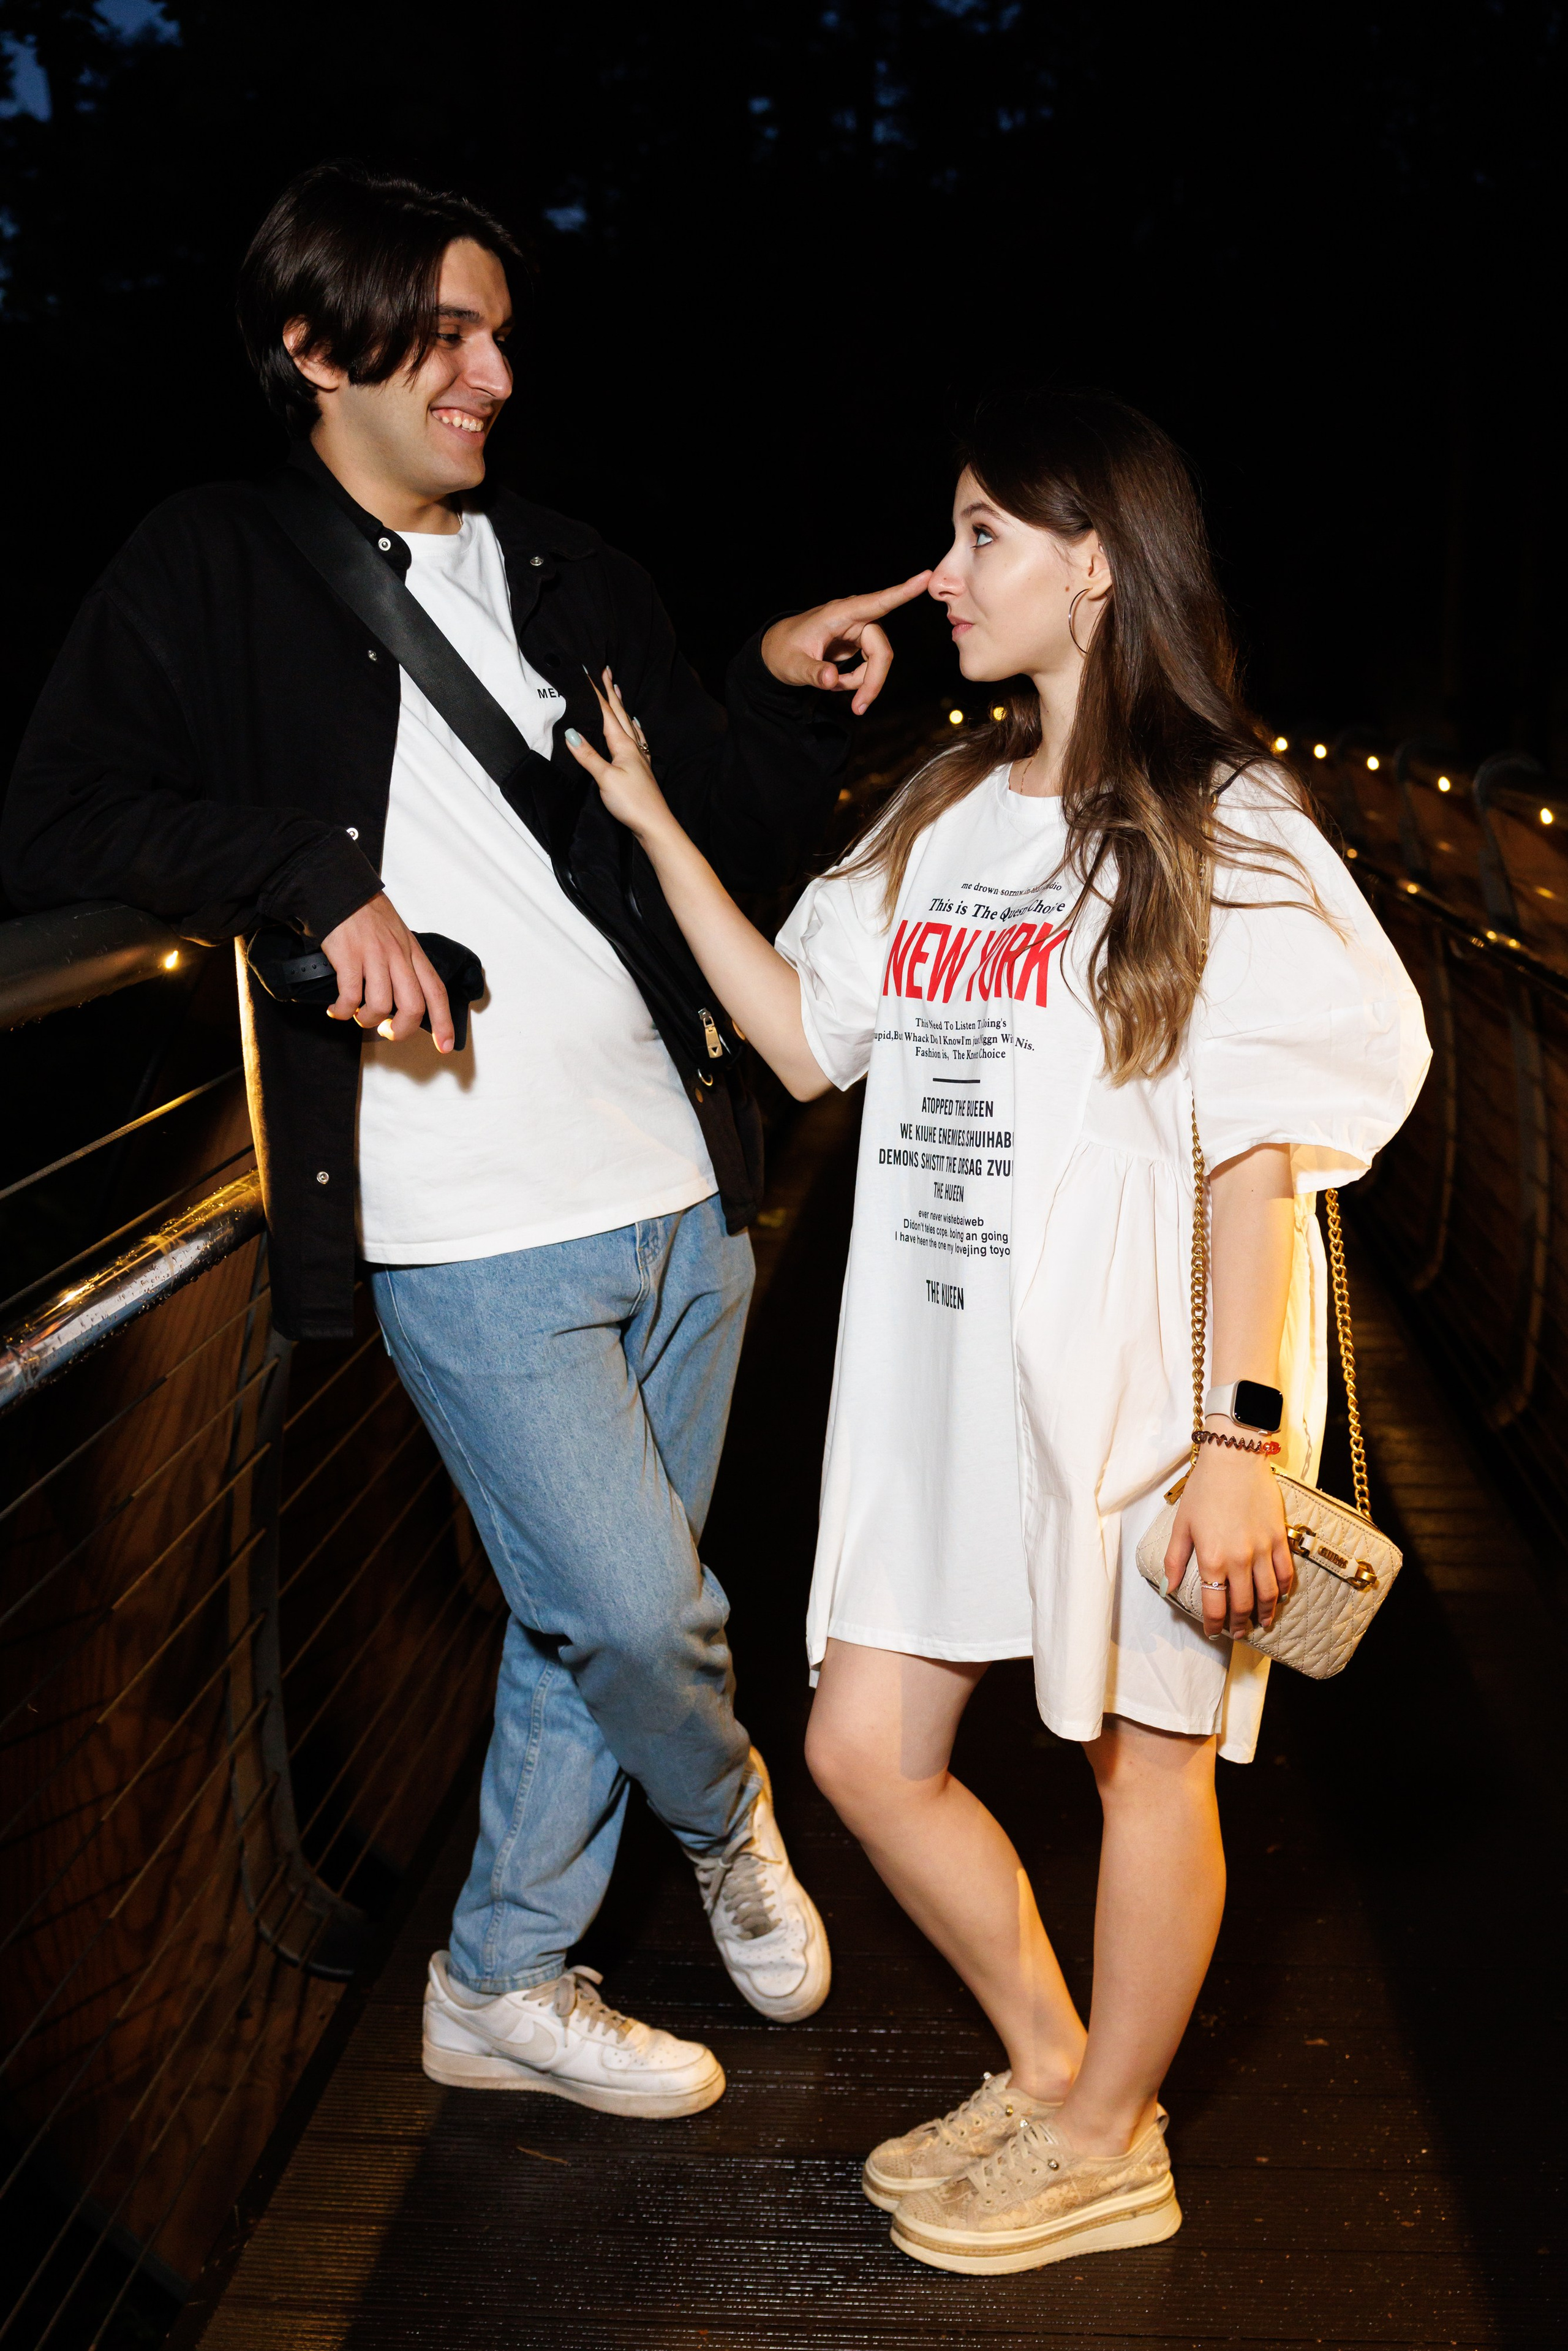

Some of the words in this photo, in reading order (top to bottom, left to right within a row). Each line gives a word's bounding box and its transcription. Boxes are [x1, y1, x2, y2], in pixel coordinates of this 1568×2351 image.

[973, 883, 999, 895] drown
[929, 898, 954, 912] This
[955, 900, 968, 915] is
[971, 904, 998, 920] The
[883, 920, 982, 1003] NEW
[965, 921, 1072, 1008] YORK
[915, 1017, 929, 1028] This
[929, 1020, 943, 1030] Need
[944, 1021, 954, 1030] To
[956, 1021, 976, 1030] Listen
[905, 1032, 929, 1043] Whack
[930, 1035, 938, 1044] Do
[915, 1047, 941, 1059] Fashion
[952, 1049, 965, 1060] The
[978, 1048, 1006, 1059] Choice
[922, 1096, 954, 1115] ATOPPED
[955, 1100, 966, 1117] THE
[900, 1123, 913, 1140] WE
[879, 1149, 919, 1168] DEMONS
[921, 1153, 945, 1171] SHISTIT
[946, 1156, 957, 1174] THE
[933, 1182, 943, 1199] THE
[944, 1183, 964, 1202] HUEEN
[930, 1212, 943, 1221] never
[895, 1231, 897, 1240] I
[900, 1232, 916, 1243] have
[938, 1241, 946, 1250] one
[947, 1243, 954, 1254] my
[981, 1231, 1008, 1244] going
[925, 1279, 940, 1304] THE
[941, 1283, 964, 1310] KUEEN
